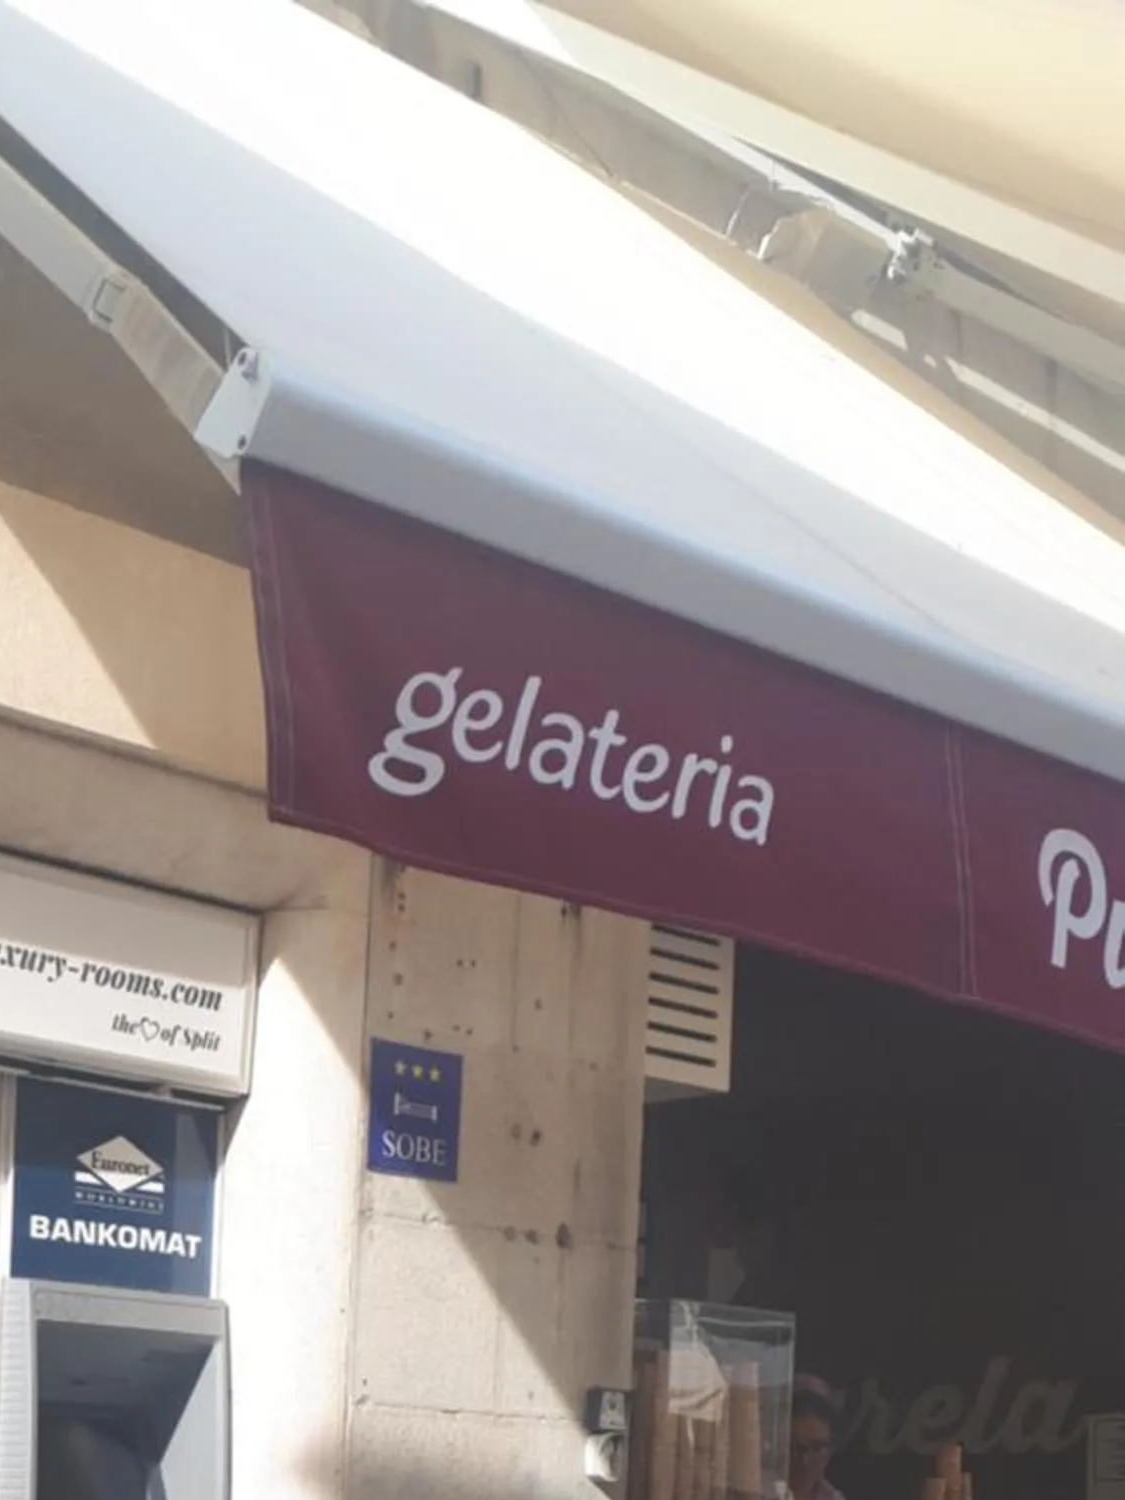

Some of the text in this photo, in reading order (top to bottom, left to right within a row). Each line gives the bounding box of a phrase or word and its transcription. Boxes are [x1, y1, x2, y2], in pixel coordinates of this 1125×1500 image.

[367, 667, 775, 845] gelateria
[111, 1012, 221, 1052] the of Split
[90, 1150, 150, 1177] Euronet
[381, 1129, 447, 1166] SOBE
[29, 1214, 203, 1259] BANKOMAT
